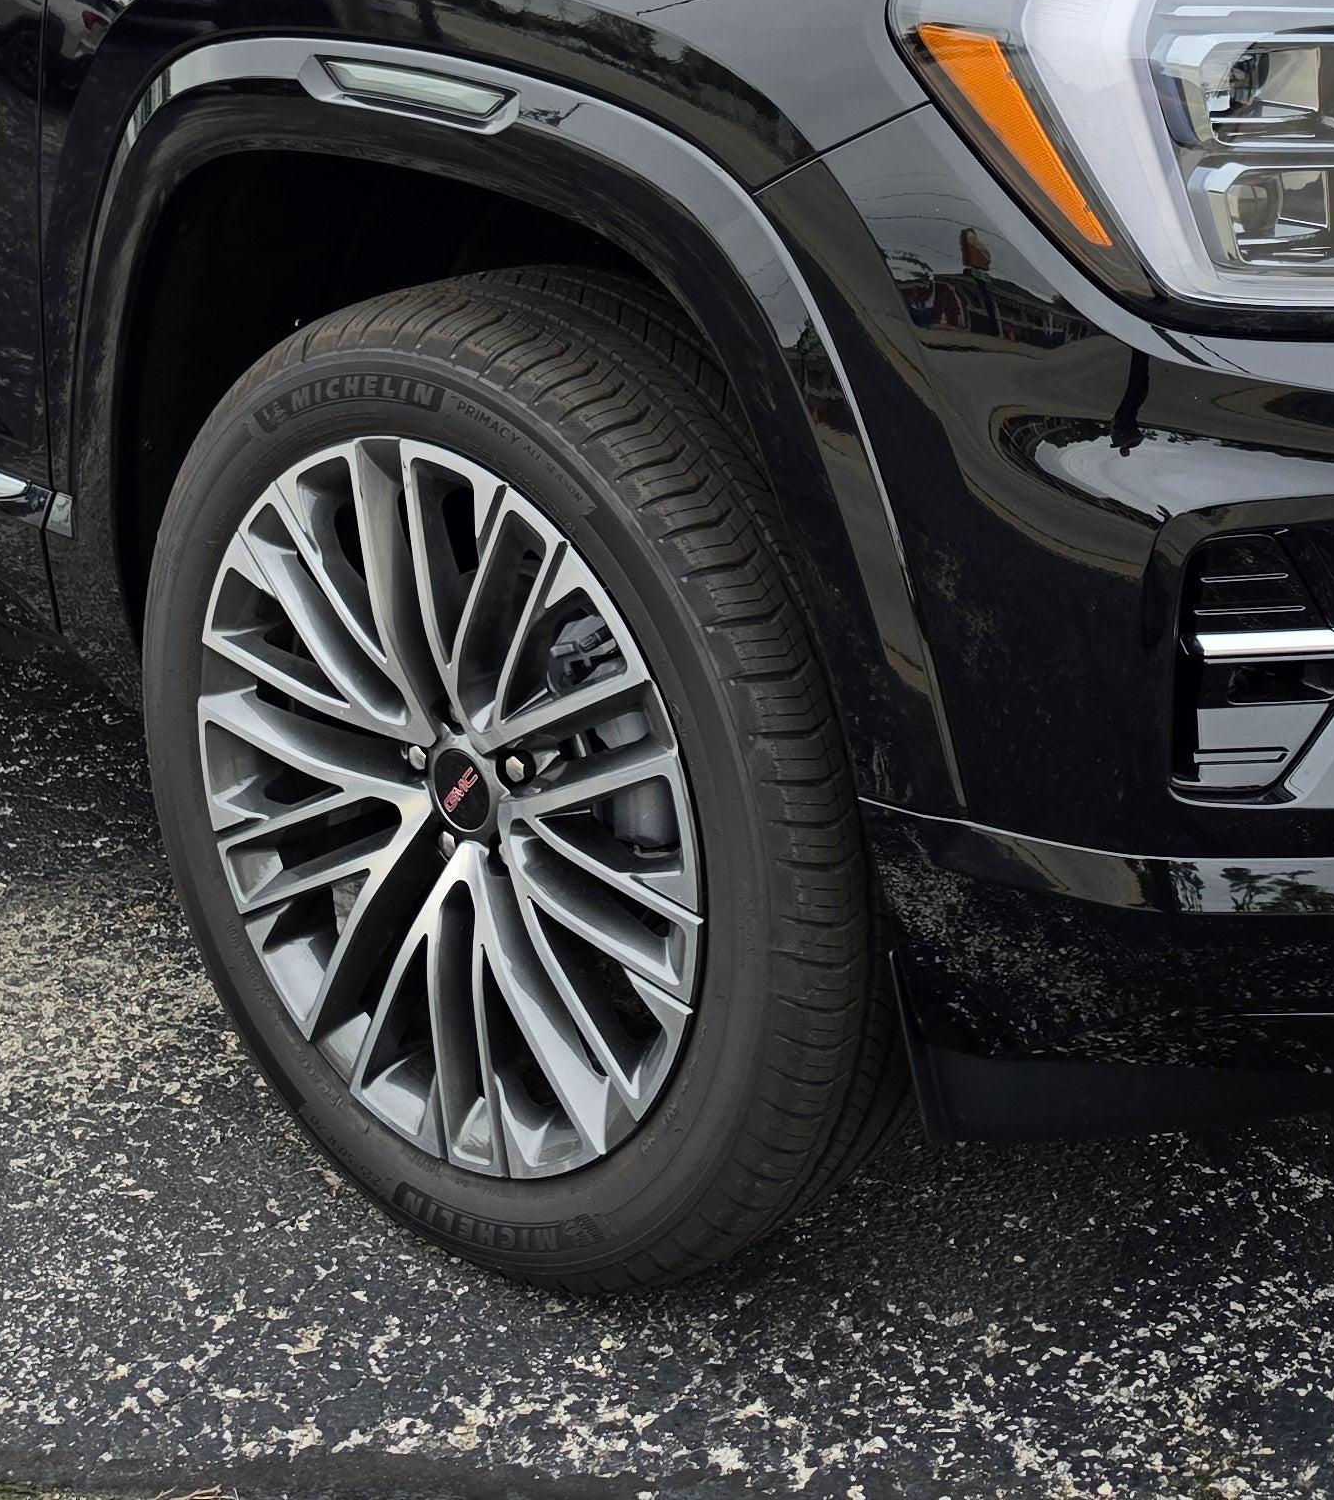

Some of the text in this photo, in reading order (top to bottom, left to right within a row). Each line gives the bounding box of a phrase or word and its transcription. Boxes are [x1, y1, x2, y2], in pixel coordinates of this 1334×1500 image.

[290, 375, 436, 412] MICHELIN
[456, 400, 521, 445] PRIMACY
[523, 445, 543, 461] ALL
[545, 462, 584, 502] SEASON
[443, 765, 479, 813] GMC
[404, 1190, 560, 1250] MICHELIN
